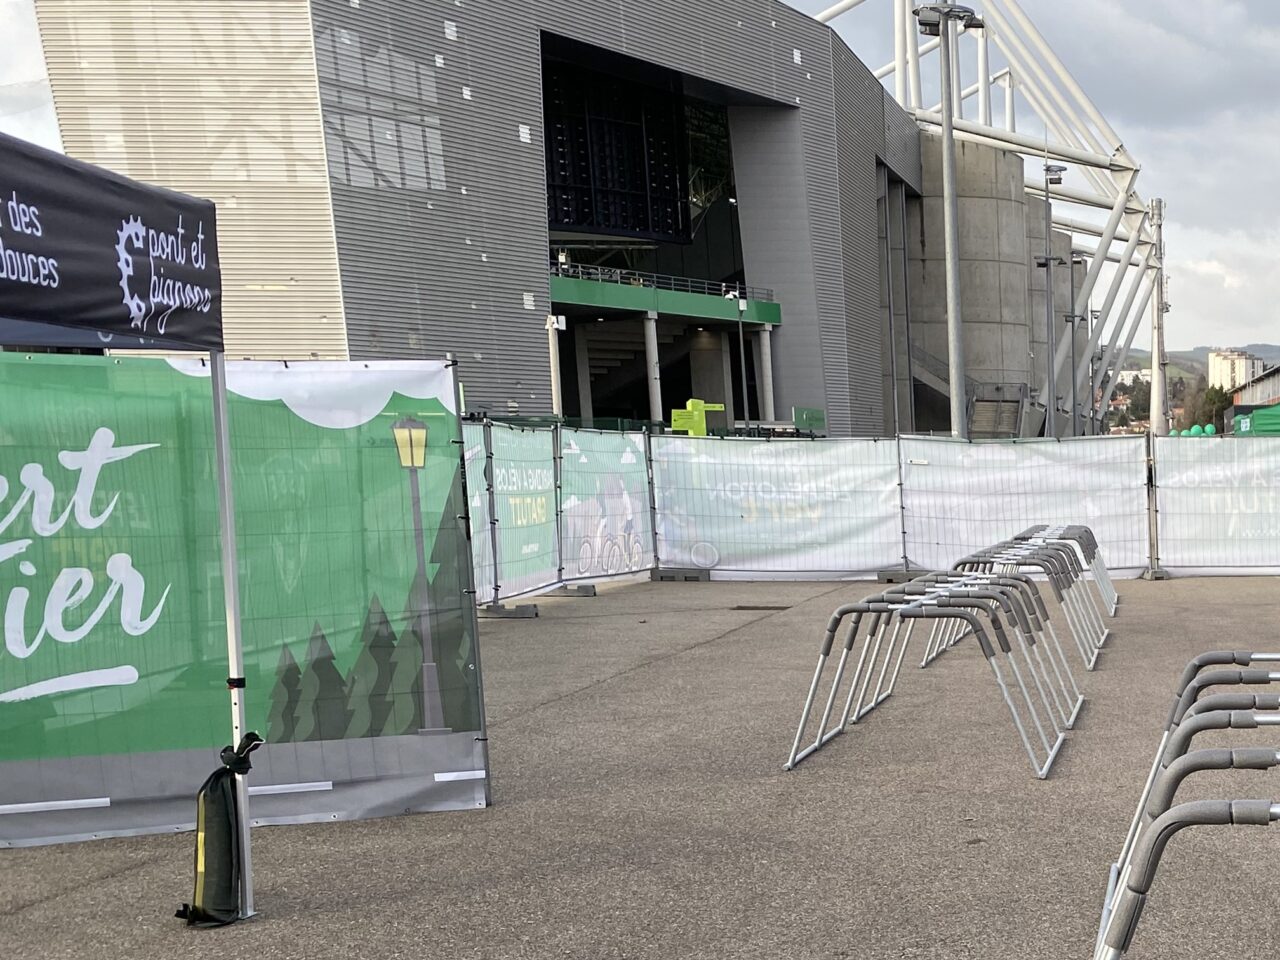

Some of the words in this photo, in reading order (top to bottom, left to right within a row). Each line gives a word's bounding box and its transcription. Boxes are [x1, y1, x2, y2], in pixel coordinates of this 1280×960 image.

[8, 190, 42, 237] des
[149, 214, 186, 274] pont
[191, 220, 205, 271] et
[144, 267, 211, 335] pignons
